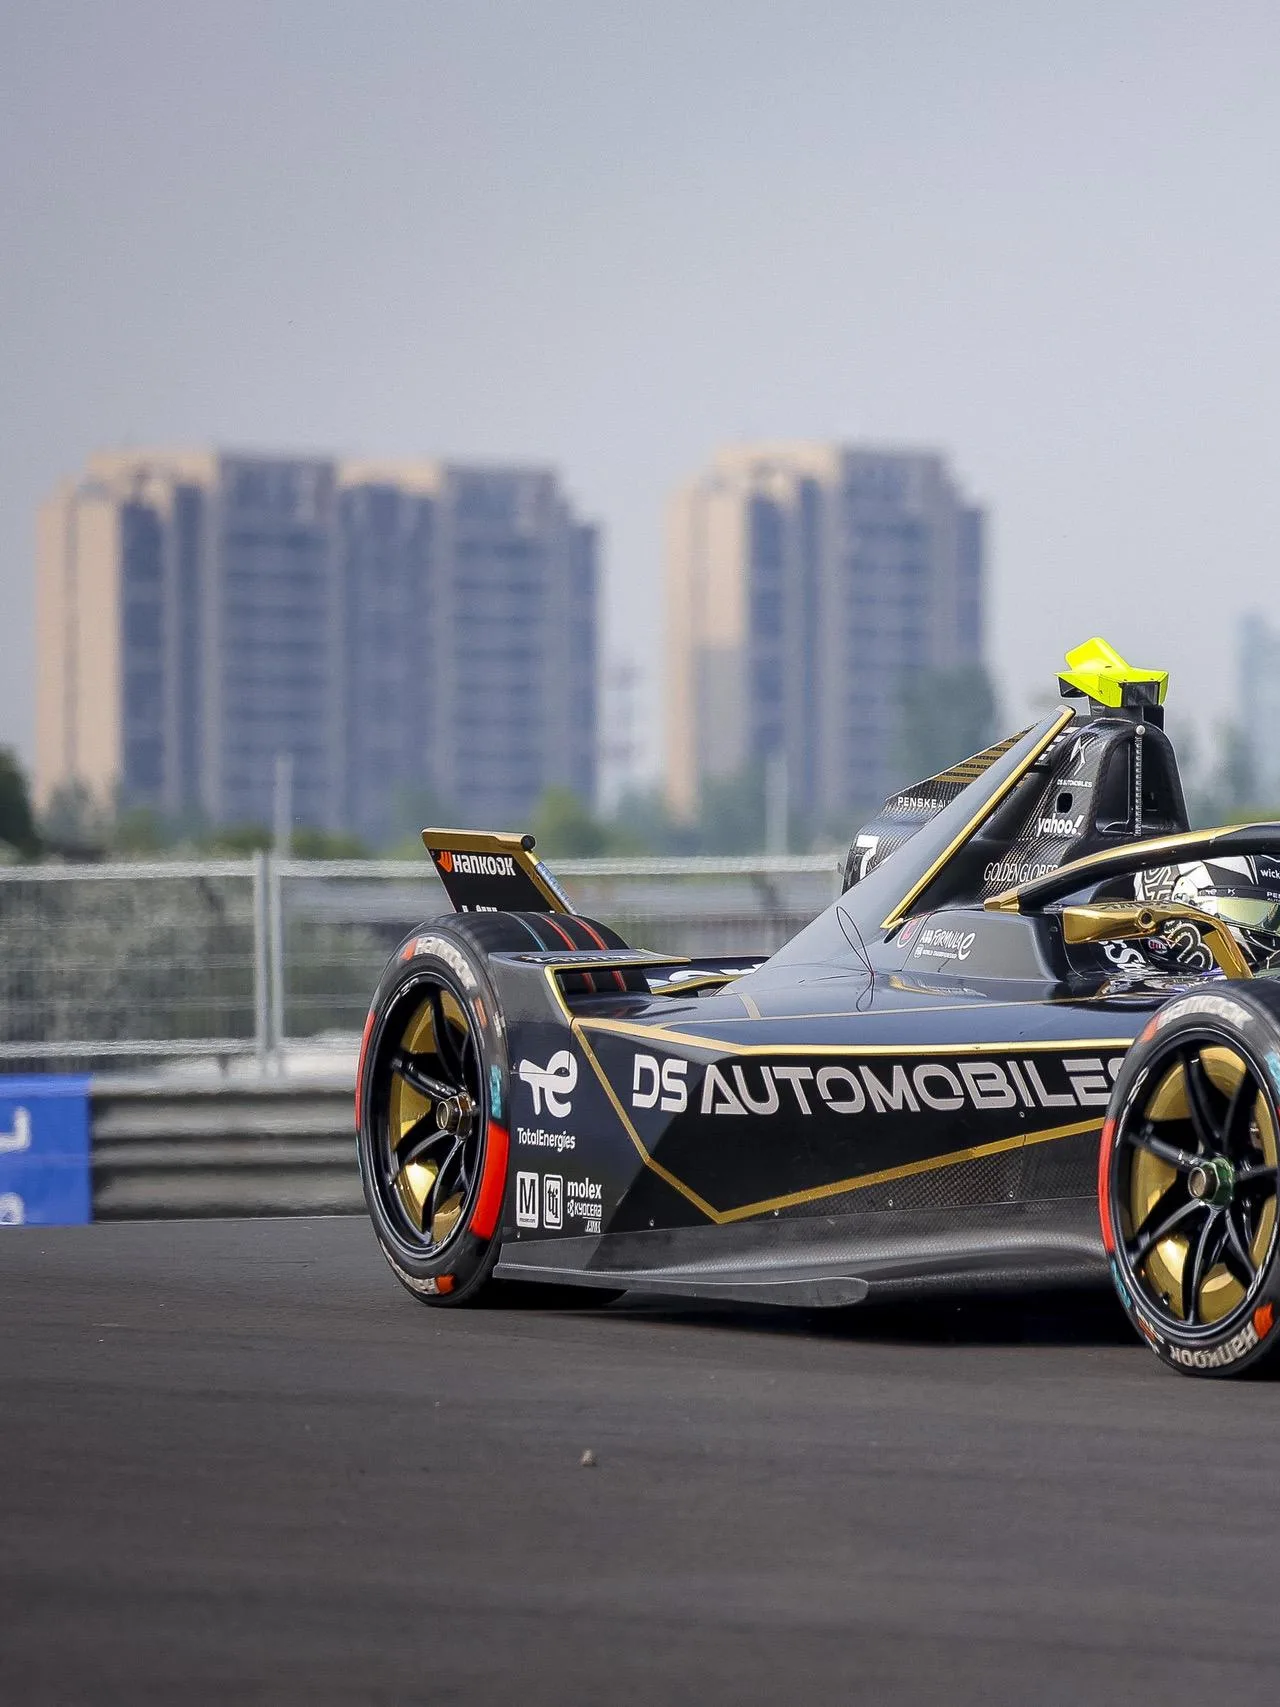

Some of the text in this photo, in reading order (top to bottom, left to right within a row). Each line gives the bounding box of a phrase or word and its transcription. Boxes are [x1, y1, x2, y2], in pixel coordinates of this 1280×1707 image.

[1036, 813, 1085, 837] yahoo!
[632, 1053, 688, 1112] DS
[517, 1127, 576, 1153] TotalEnergies
[567, 1177, 602, 1199] molex
[574, 1202, 602, 1218] KYOCERA
